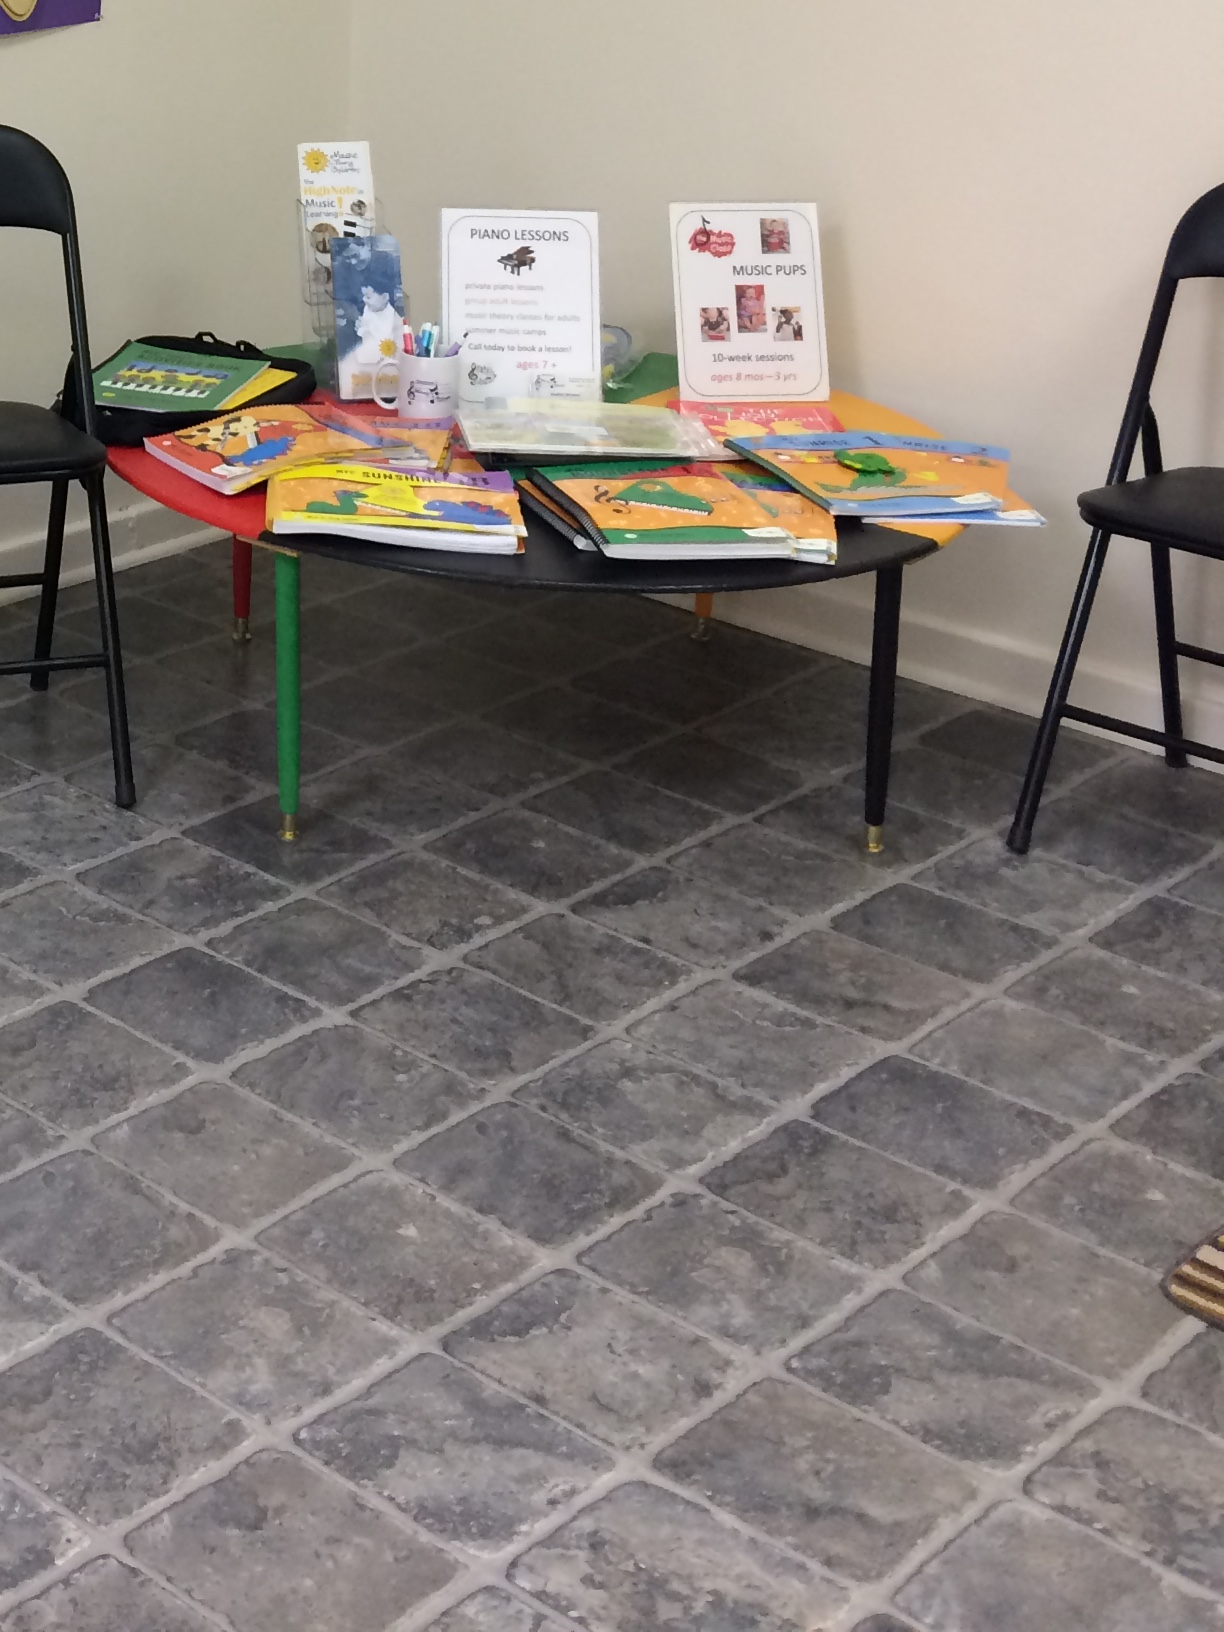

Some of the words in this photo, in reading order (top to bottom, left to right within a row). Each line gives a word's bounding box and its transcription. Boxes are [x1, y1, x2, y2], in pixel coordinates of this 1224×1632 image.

[305, 199, 336, 208] Music
[470, 229, 510, 240] PIANO
[515, 230, 569, 241] LESSONS
[733, 265, 772, 276] MUSIC
[776, 265, 807, 276] PUPS
[468, 343, 482, 351] Call
[484, 344, 505, 352] today
[517, 344, 536, 352] book
[545, 345, 572, 353] lesson!
[712, 353, 752, 362] 10-week
[755, 353, 794, 362] sessions
[516, 362, 539, 370] ages
[543, 361, 548, 369] 7
[711, 373, 733, 382] ages
[736, 372, 742, 381] 8
[783, 373, 797, 382] yrs
